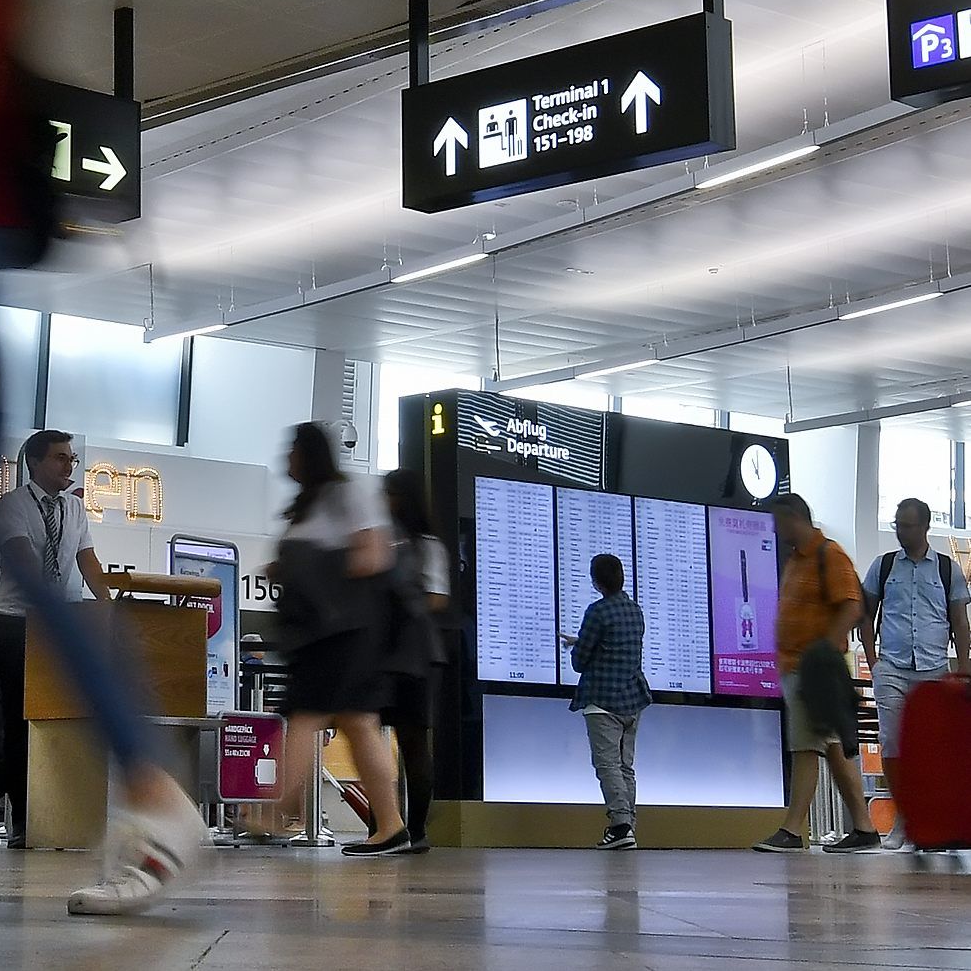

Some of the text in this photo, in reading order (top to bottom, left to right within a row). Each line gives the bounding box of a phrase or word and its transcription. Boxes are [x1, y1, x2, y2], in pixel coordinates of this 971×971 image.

[532, 78, 609, 111] Terminal 1
[533, 103, 598, 131] Check-in
[506, 418, 547, 441] Abflug
[506, 438, 570, 460] Departure
[241, 574, 284, 602] 156
[509, 671, 525, 679] 11:00
